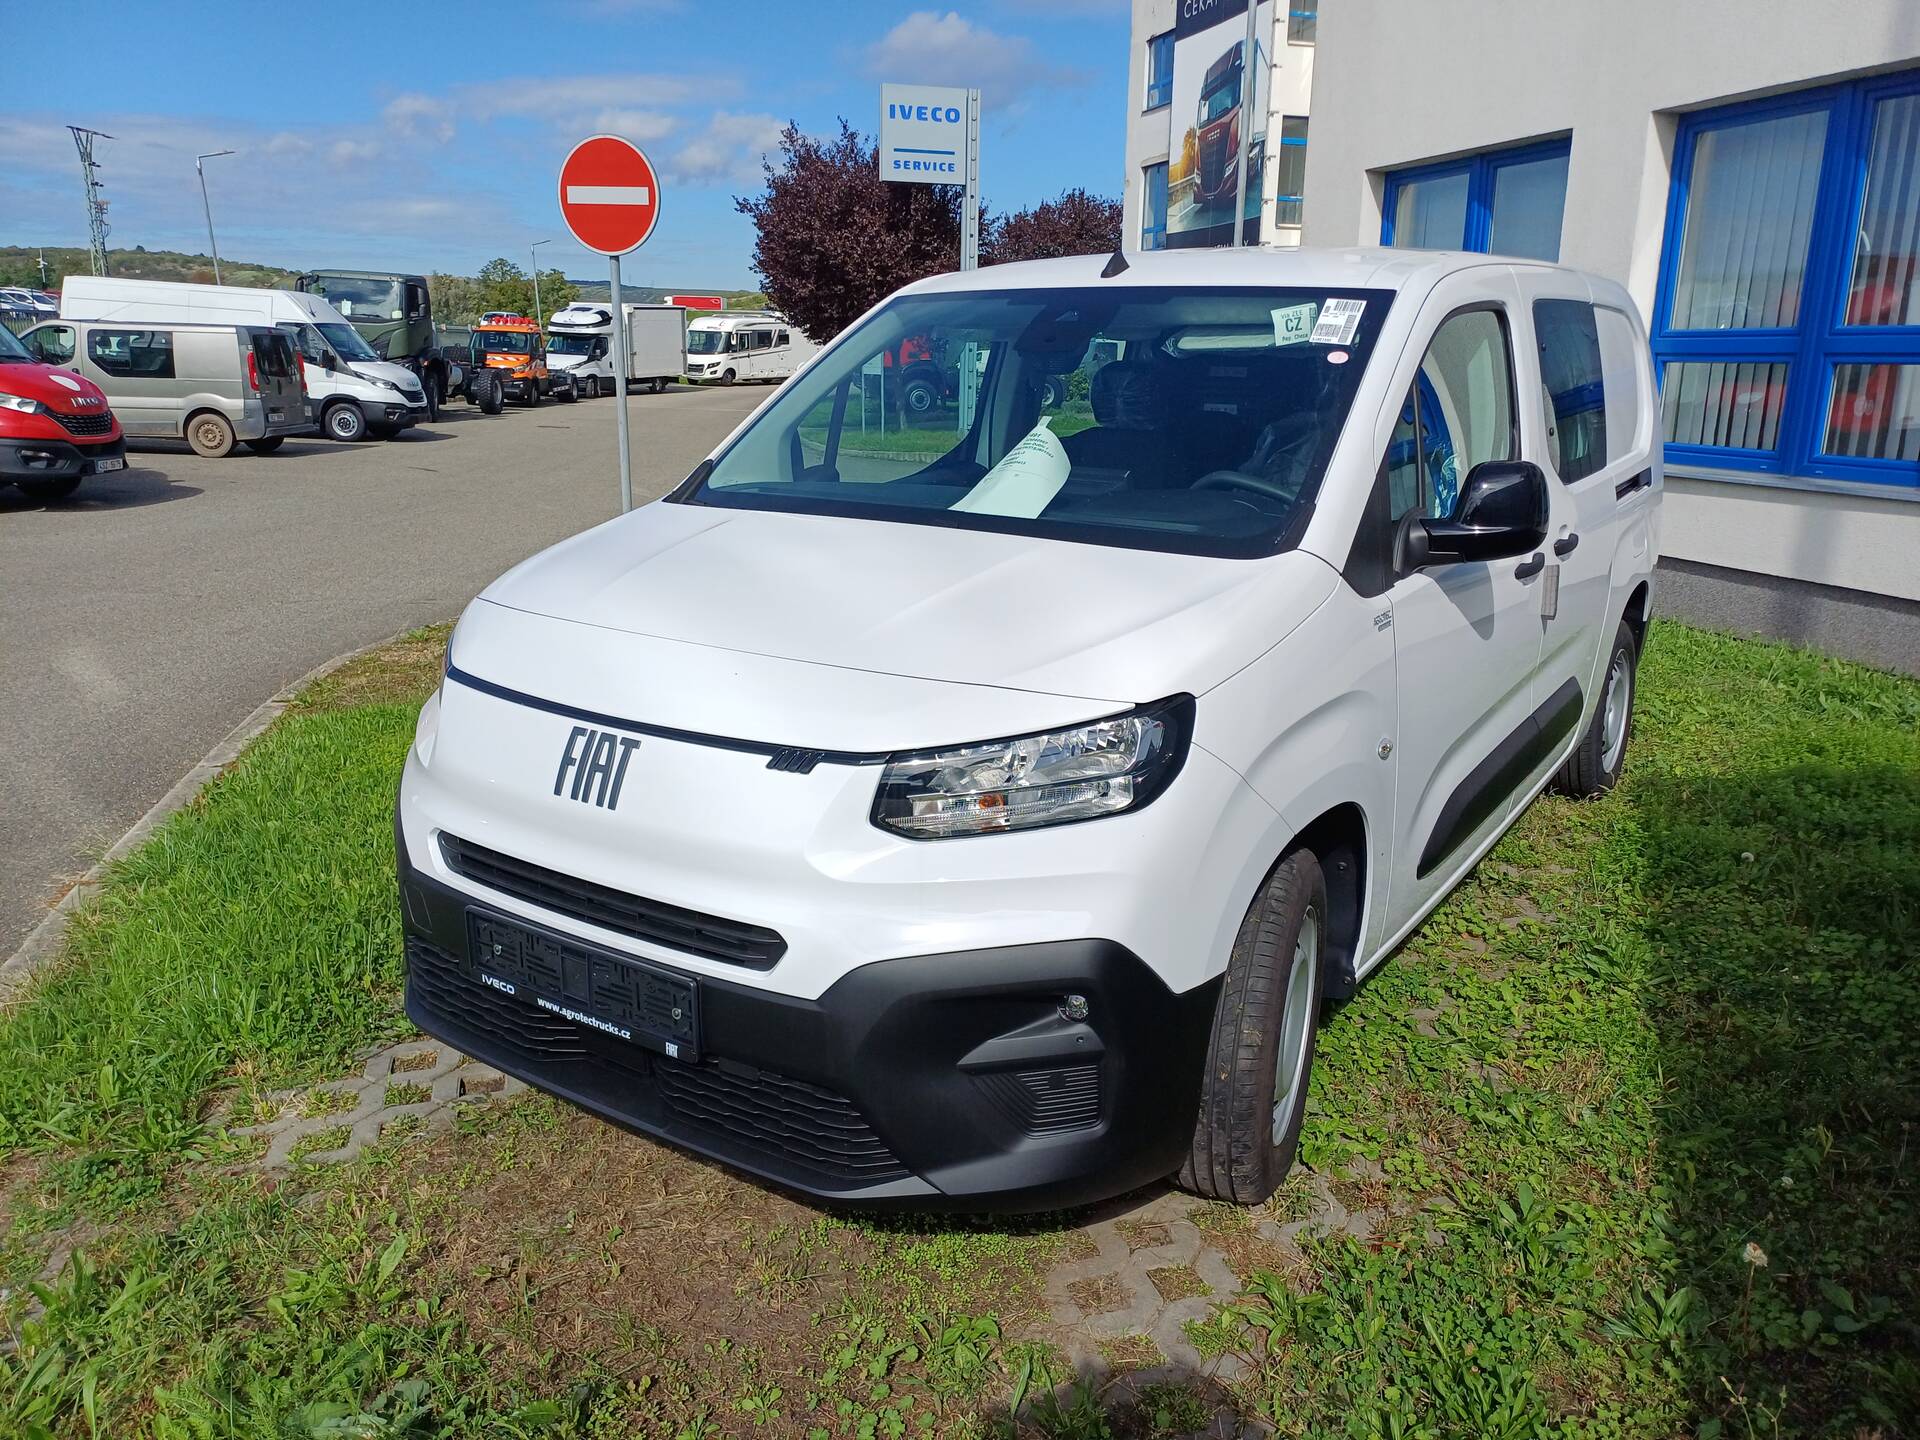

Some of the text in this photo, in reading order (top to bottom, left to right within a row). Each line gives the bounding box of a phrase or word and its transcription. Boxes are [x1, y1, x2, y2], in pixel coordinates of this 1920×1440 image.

[889, 104, 960, 123] IVECO
[893, 160, 955, 172] SERVICE
[1285, 317, 1302, 332] CZ
[553, 725, 642, 811] FIAT
[481, 974, 515, 995] IVECO
[537, 997, 631, 1039] www.agrotectrucks.cz
[665, 1042, 679, 1059] FIAT
